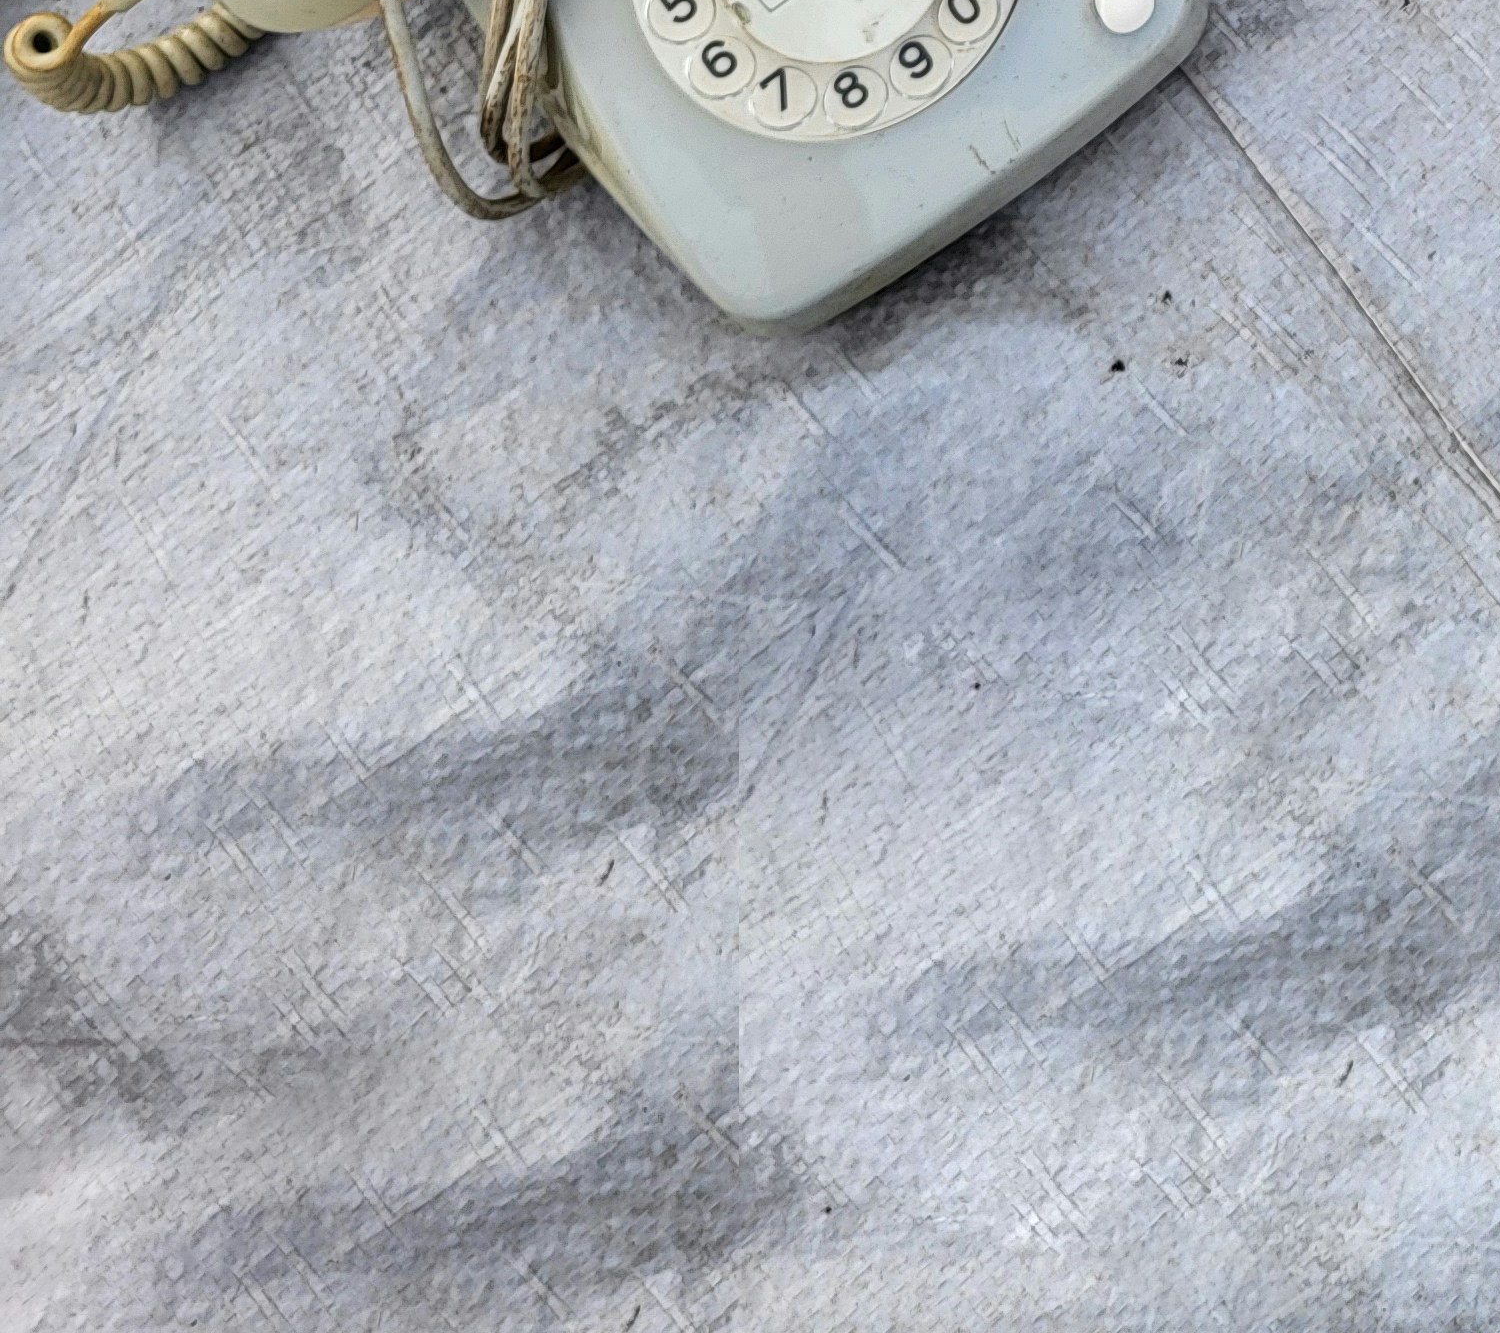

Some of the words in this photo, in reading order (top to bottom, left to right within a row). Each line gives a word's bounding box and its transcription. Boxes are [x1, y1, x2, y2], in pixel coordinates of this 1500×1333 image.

[701, 41, 737, 78] 6
[760, 68, 789, 112] 7
[834, 71, 869, 109] 8
[899, 42, 933, 78] 9
